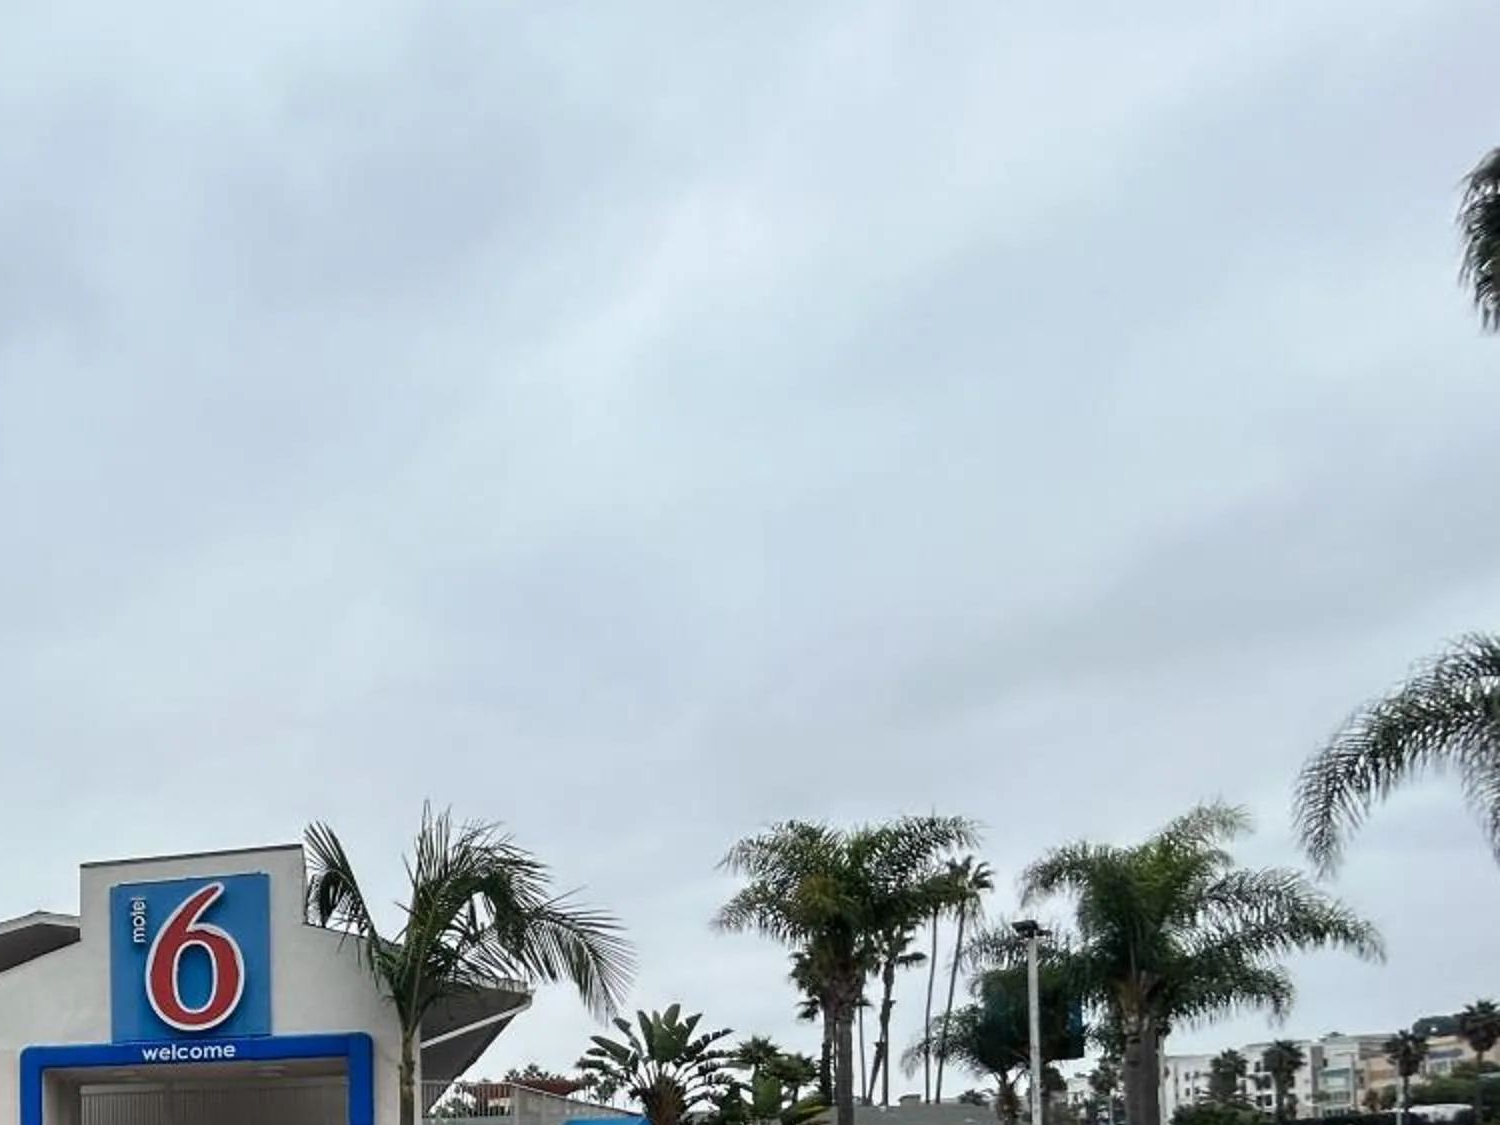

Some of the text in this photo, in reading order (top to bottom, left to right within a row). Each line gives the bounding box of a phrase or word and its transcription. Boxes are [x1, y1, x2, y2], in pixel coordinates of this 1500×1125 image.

[131, 882, 245, 1031] motel 6
[142, 1043, 236, 1061] welcome
